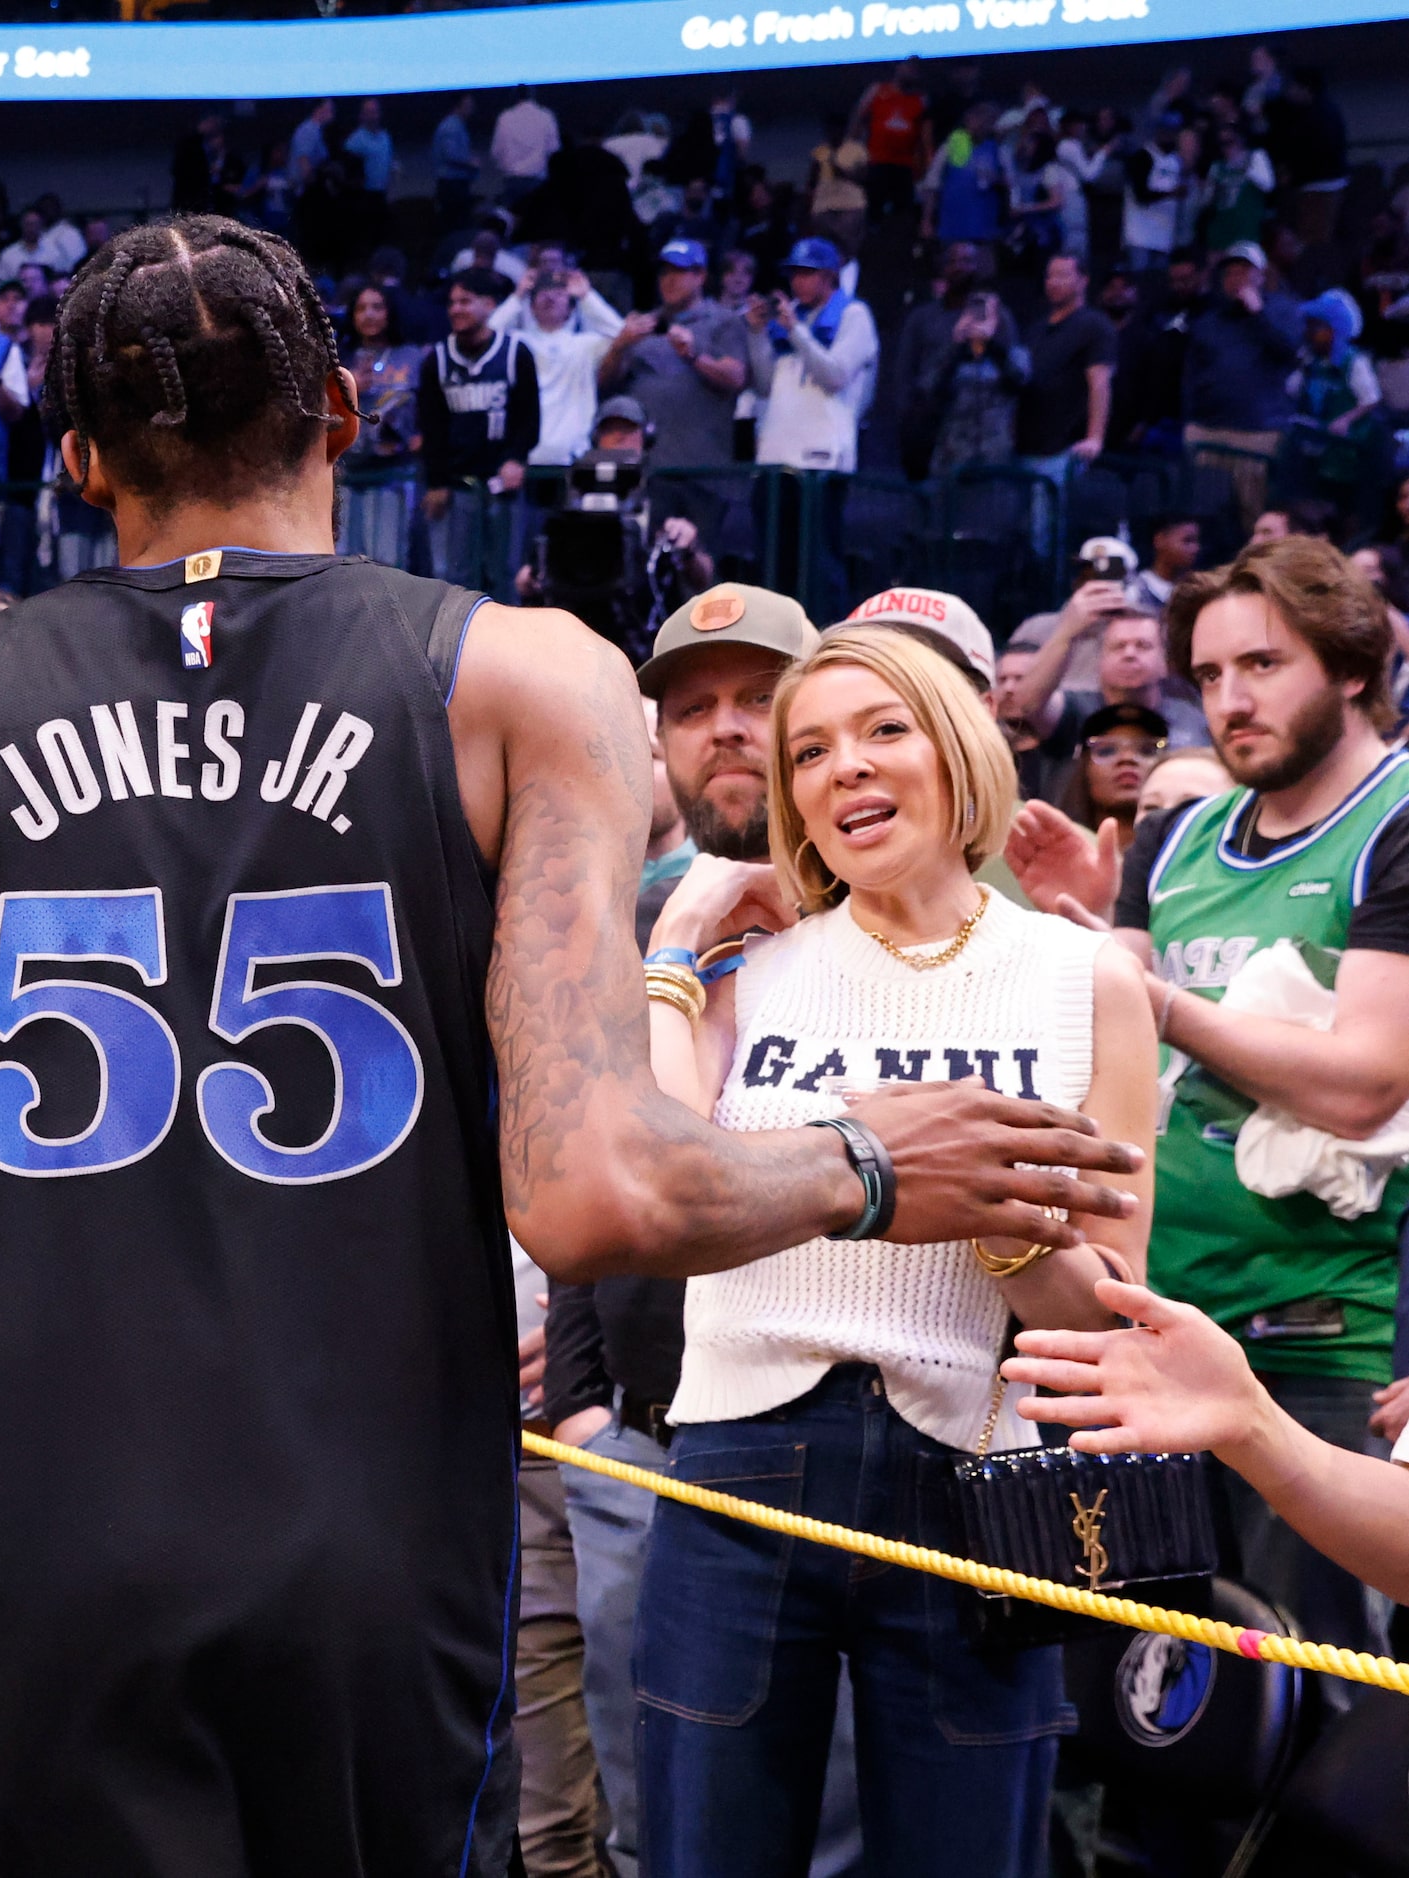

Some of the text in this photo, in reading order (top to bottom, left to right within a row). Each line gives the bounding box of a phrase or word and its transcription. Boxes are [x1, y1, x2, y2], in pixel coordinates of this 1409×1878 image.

[681, 15, 747, 50] Get
[754, 6, 854, 45] Fresh
[861, 3, 960, 38] From
[967, 0, 1057, 30] Your
[15, 45, 90, 78] Seat
[185, 651, 201, 667] NBA
[0, 699, 374, 841] JONES JR.
